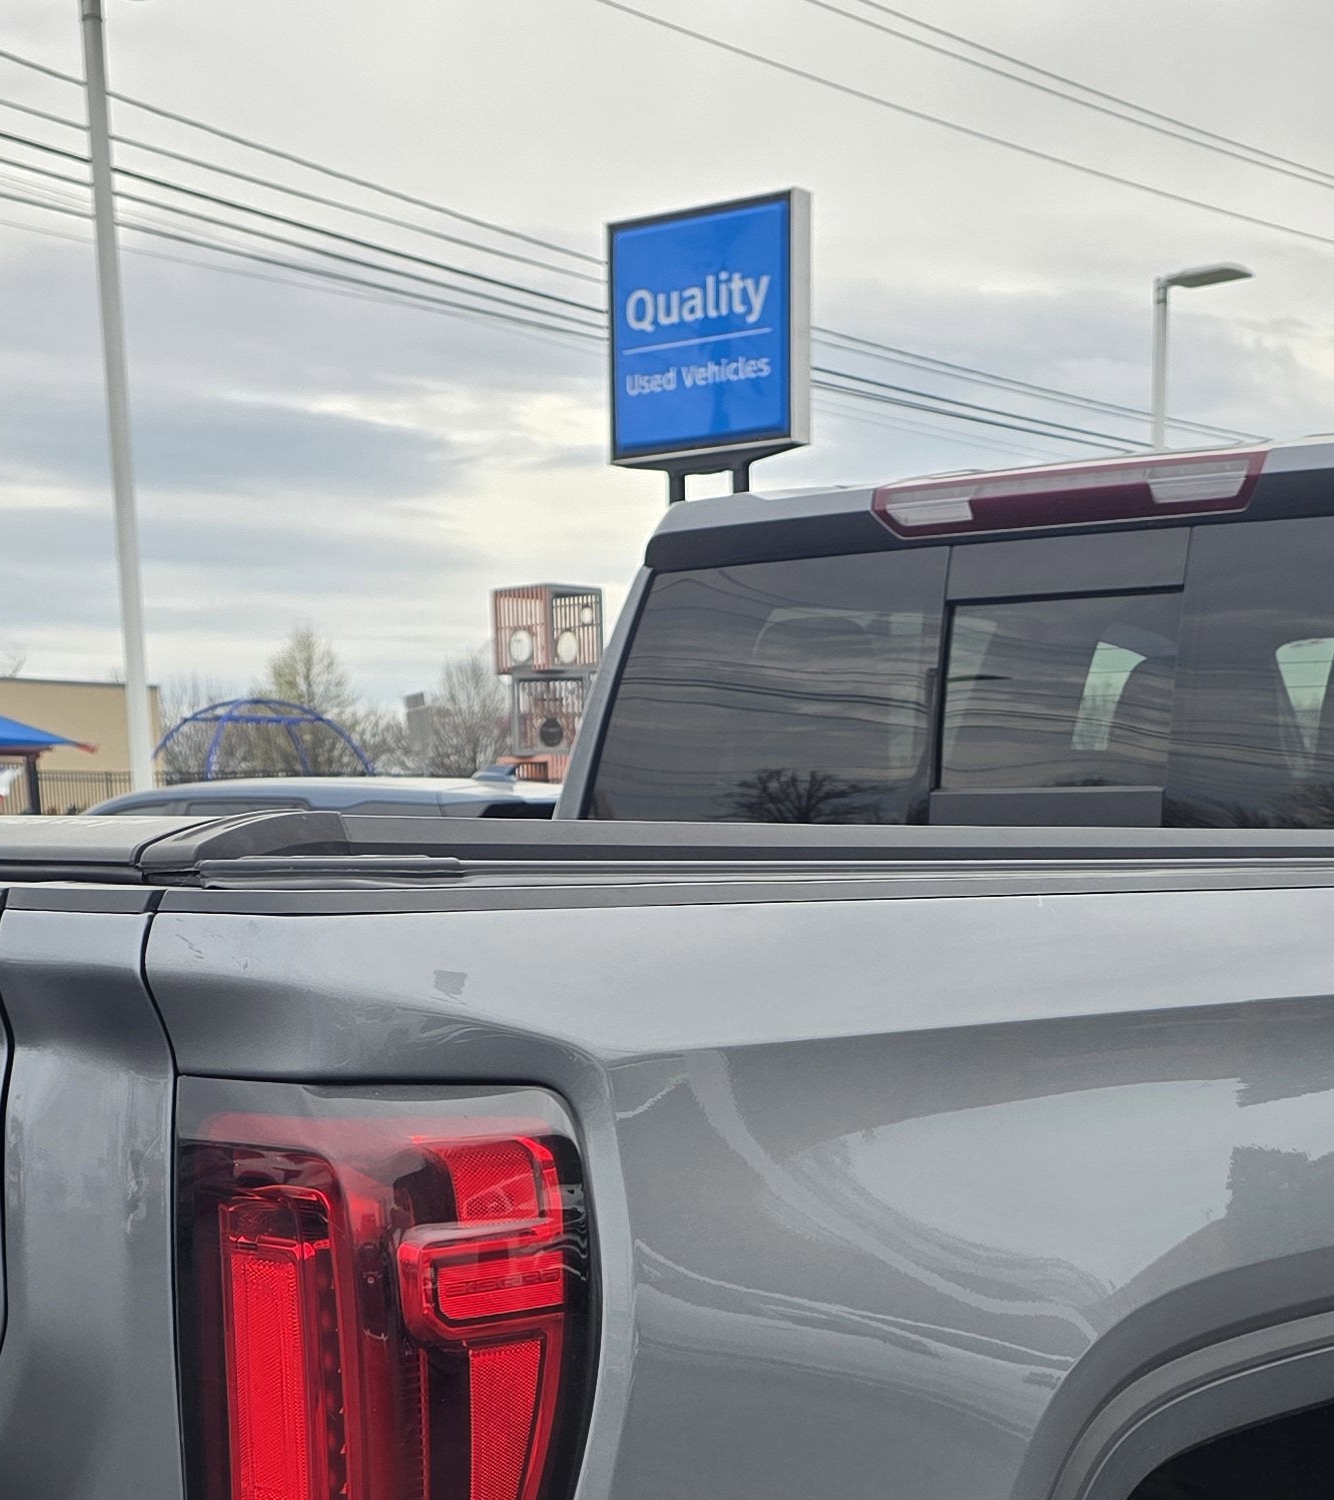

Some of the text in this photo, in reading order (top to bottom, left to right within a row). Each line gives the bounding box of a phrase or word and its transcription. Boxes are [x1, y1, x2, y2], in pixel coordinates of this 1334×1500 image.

[626, 270, 771, 332] Quality
[626, 356, 771, 395] Used Vehicles
